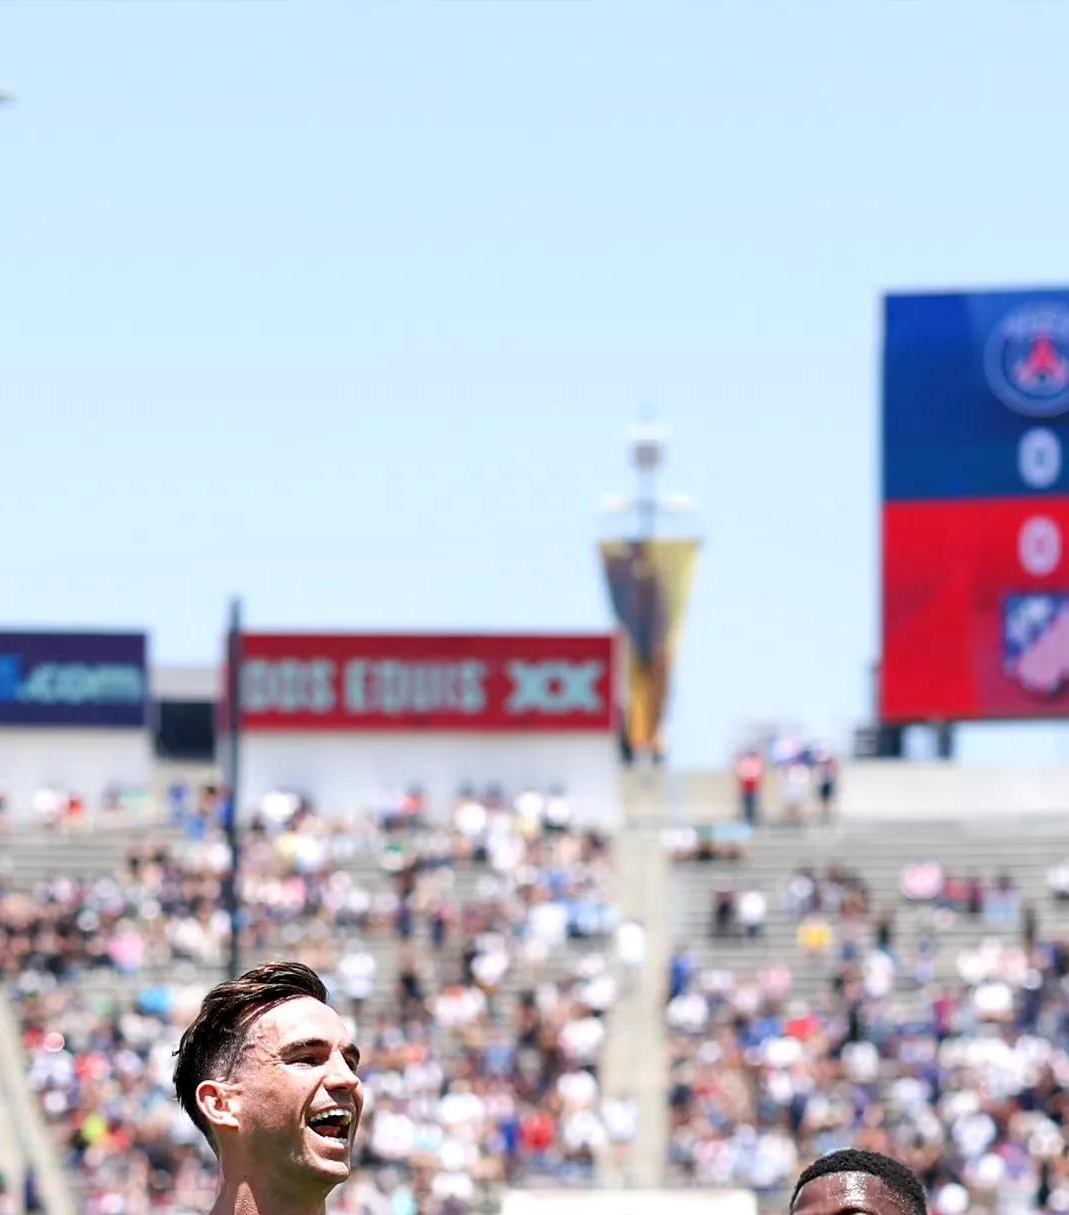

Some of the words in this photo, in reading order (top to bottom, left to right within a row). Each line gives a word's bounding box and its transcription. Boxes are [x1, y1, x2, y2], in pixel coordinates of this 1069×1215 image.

[1018, 427, 1061, 489] 0
[1018, 515, 1061, 576] 0
[506, 660, 602, 715] XX
